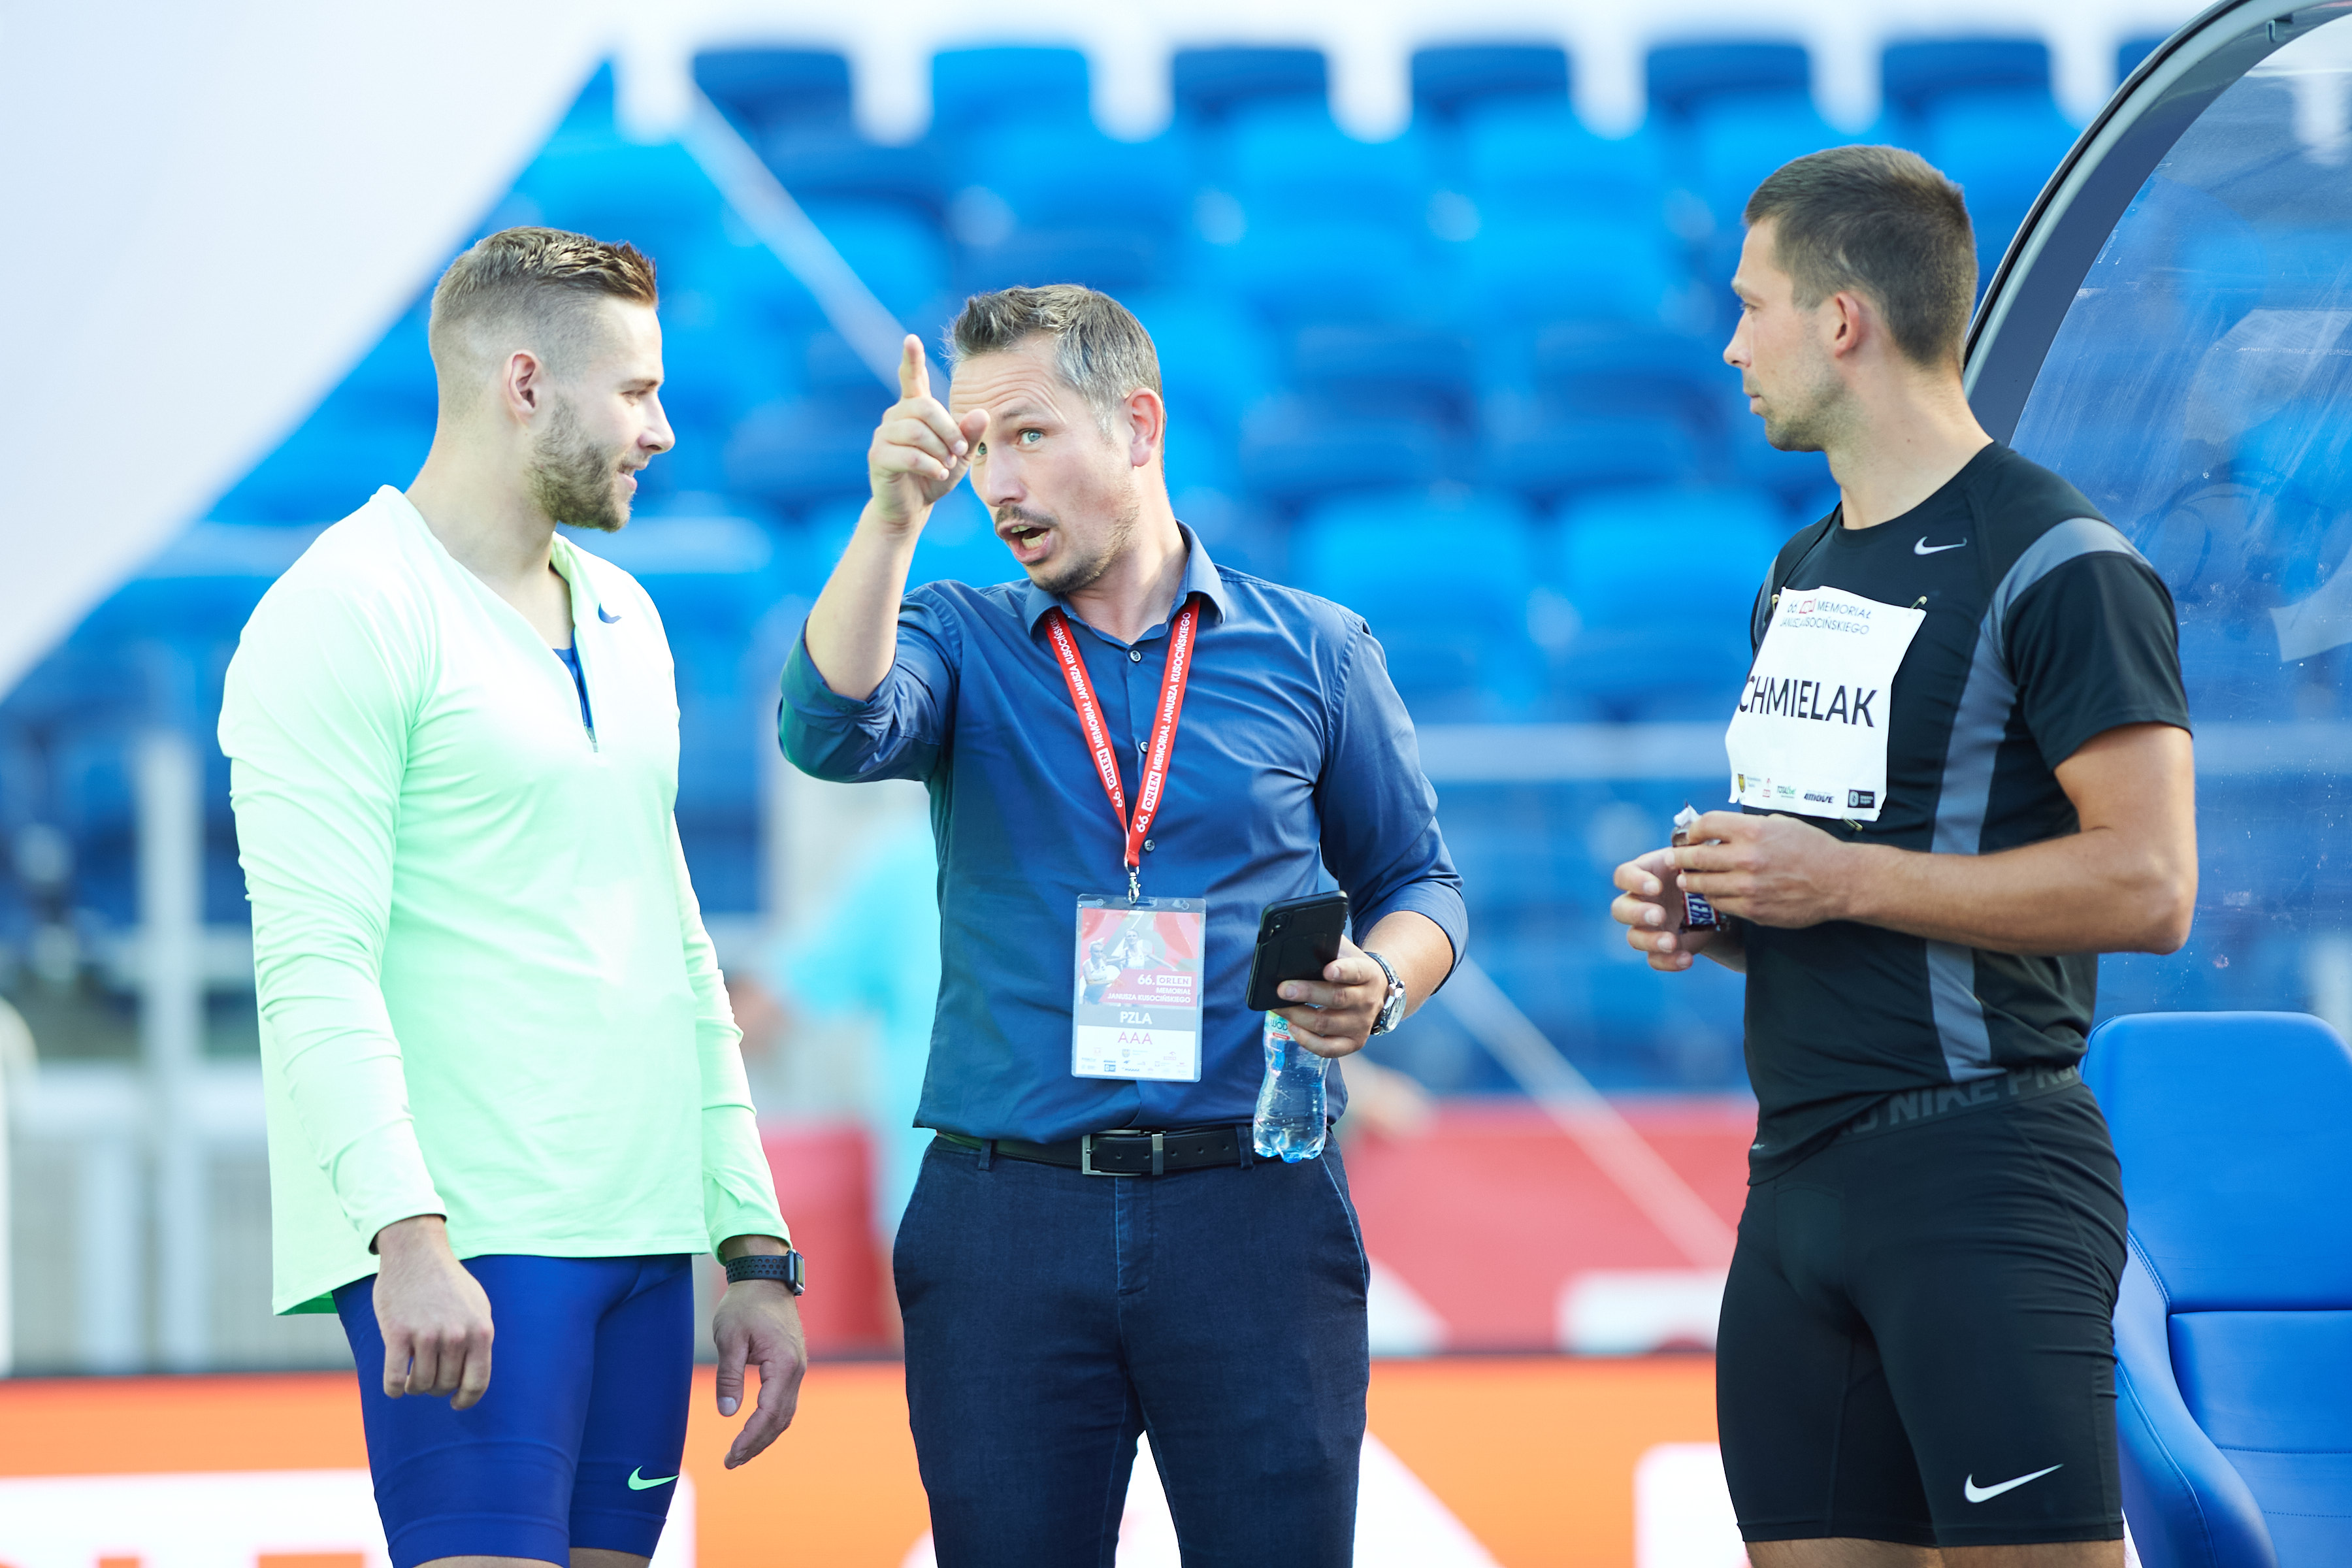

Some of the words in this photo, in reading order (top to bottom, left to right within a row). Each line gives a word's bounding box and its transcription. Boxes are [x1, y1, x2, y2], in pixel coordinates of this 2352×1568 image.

[1817, 600, 1872, 619] MEMORIAŁ
[1170, 612, 1191, 682] KUSOCIŃSKIEGO
[1069, 664, 1090, 700] JANUSZA
[1162, 685, 1179, 724] JANUSZA
[1083, 701, 1105, 748] MEMORIAŁ
[1152, 725, 1171, 771] MEMORIAŁ
[1100, 751, 1115, 785] ORLEN
[1113, 787, 1123, 808] 66.
[1145, 775, 1158, 808] ORLEN
[1135, 813, 1151, 832] 66.
[1137, 973, 1156, 985] 66.
[1137, 994, 1191, 1003] KUSOCIŃSKIEGO
[1120, 1011, 1152, 1024] PZLA
[1117, 1031, 1152, 1045] AAA
[1889, 1078, 1999, 1126] NIKE
